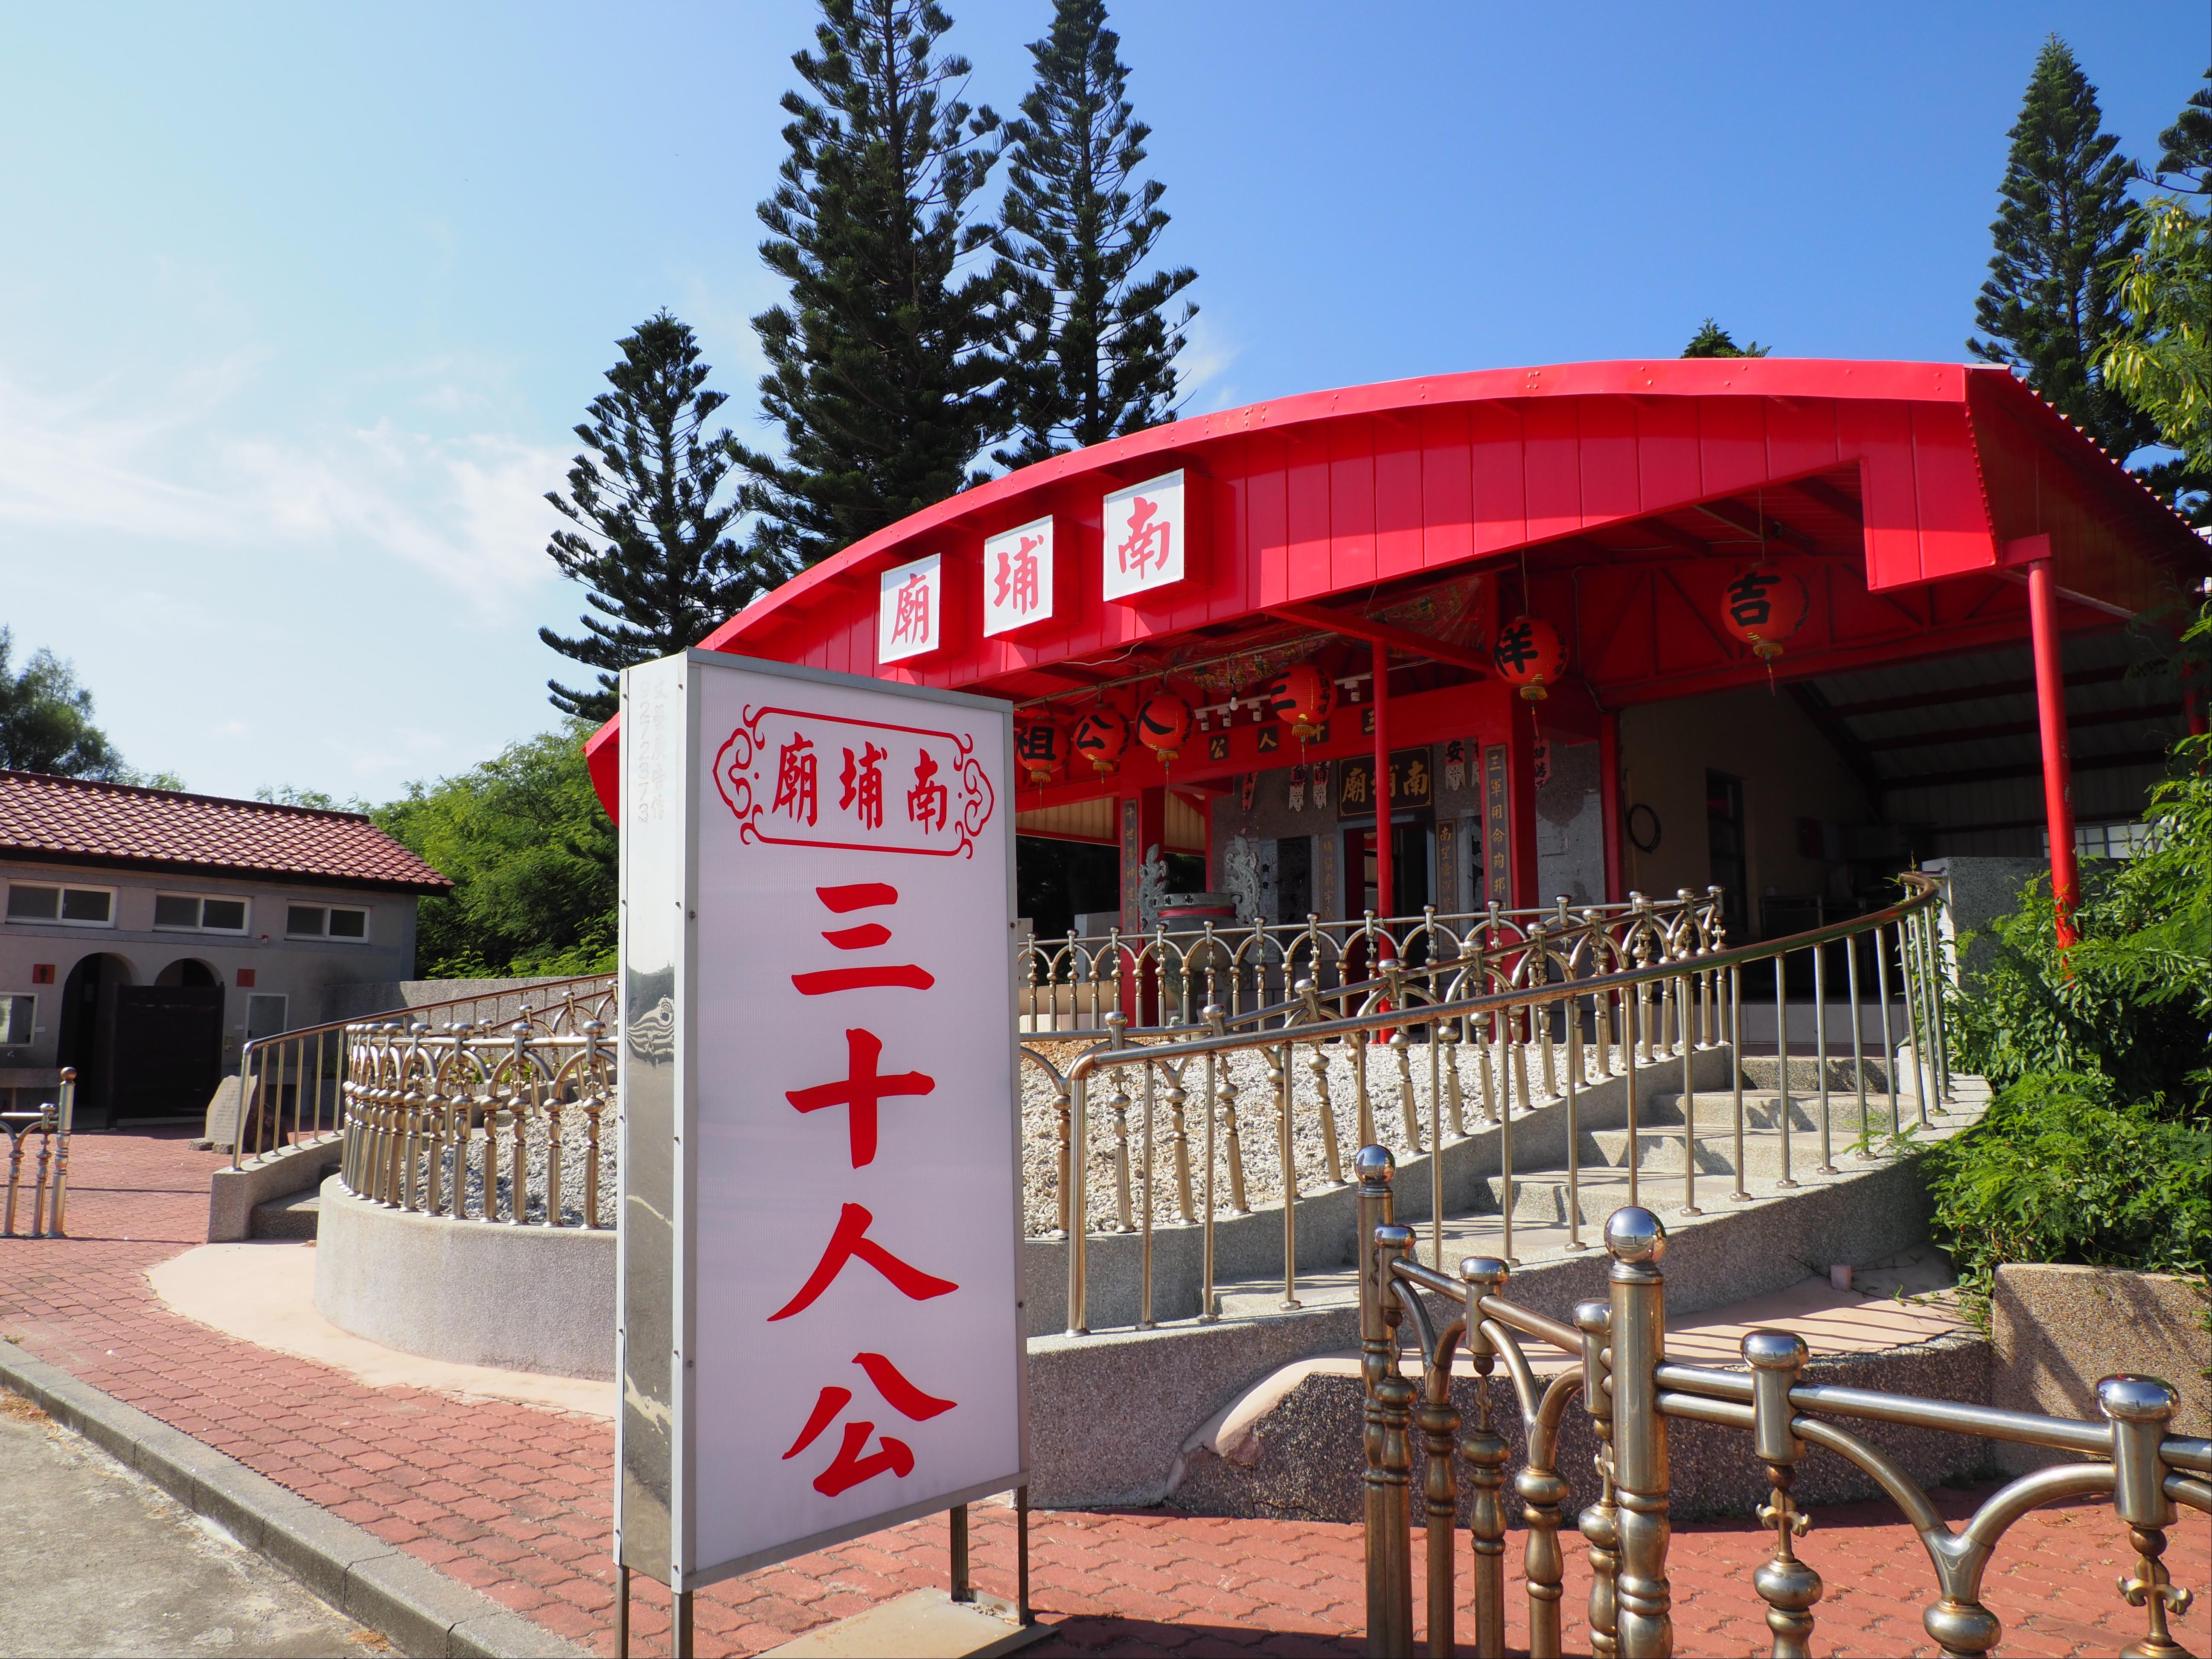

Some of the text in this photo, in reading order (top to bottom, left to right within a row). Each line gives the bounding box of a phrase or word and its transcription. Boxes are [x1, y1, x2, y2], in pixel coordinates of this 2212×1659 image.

[891, 496, 1170, 645] 南埔廟
[1728, 572, 1781, 627] 吉
[1494, 623, 1539, 677] 祥
[1135, 700, 1176, 735] 人
[1270, 672, 1296, 714] 三
[638, 681, 650, 822] 9272373
[1017, 726, 1057, 761] 祖
[1075, 715, 1114, 749] 公
[1445, 740, 1464, 763] 安
[771, 732, 948, 835] 南埔廟
[1489, 755, 1506, 918] 三軍用命殉邦
[766, 882, 959, 1497] 三十人公
